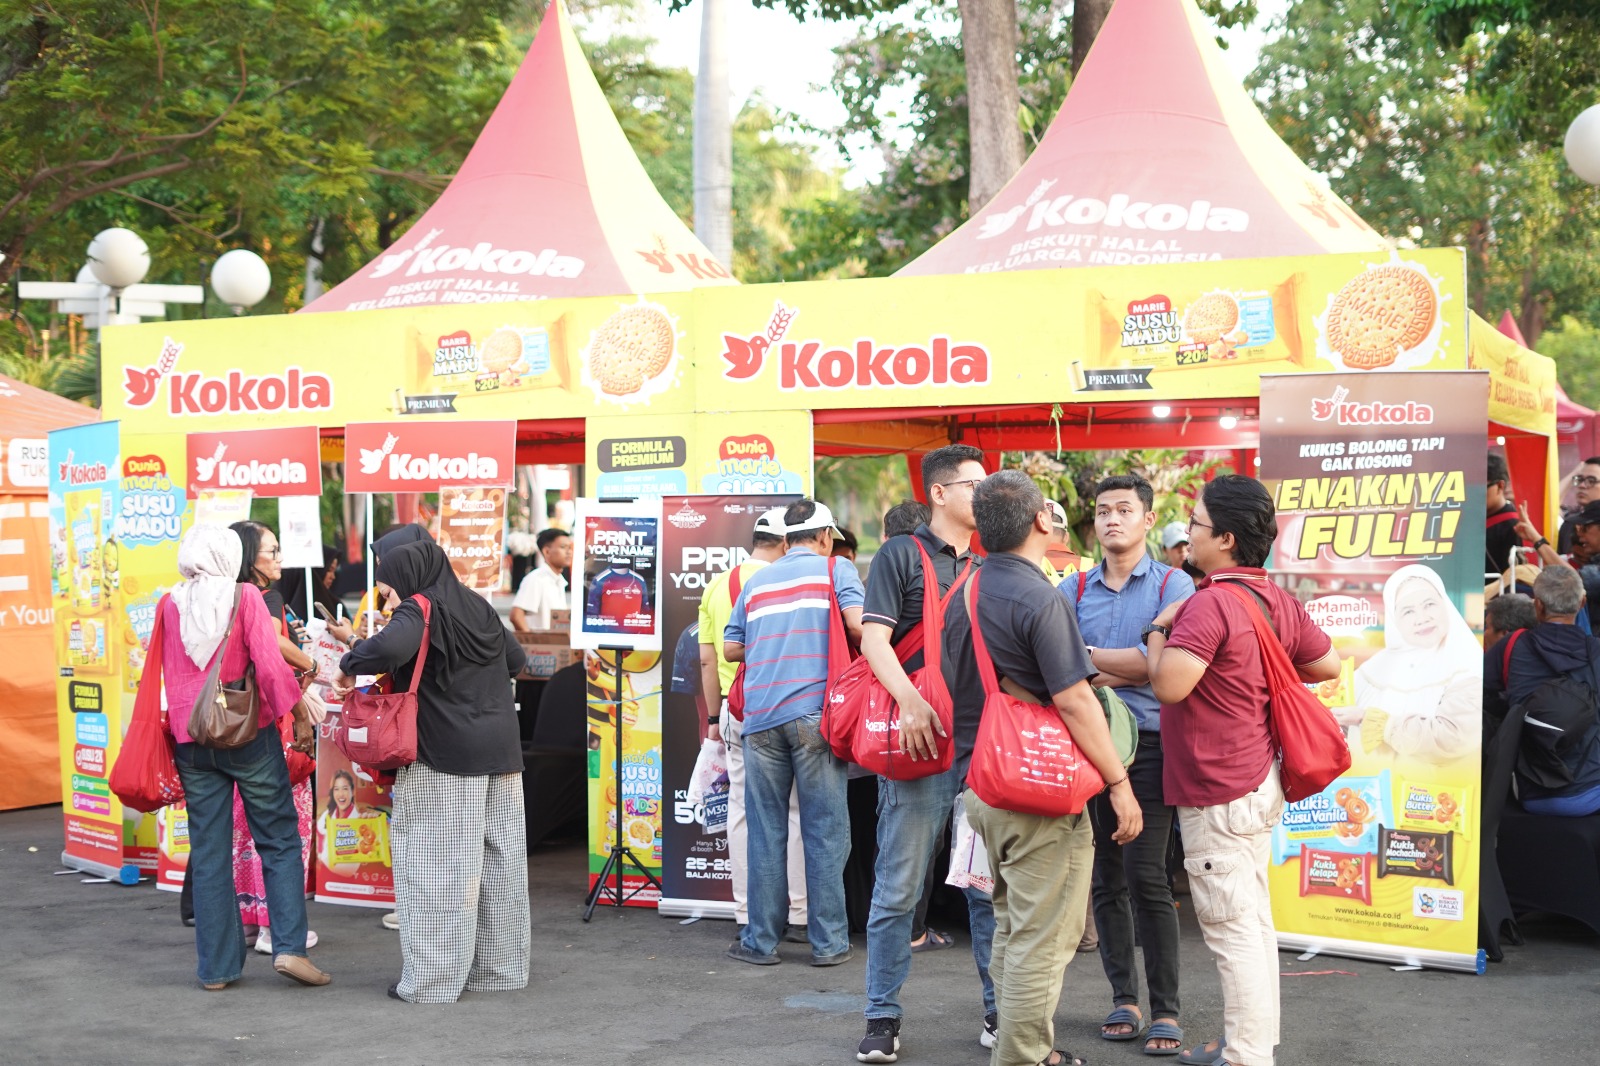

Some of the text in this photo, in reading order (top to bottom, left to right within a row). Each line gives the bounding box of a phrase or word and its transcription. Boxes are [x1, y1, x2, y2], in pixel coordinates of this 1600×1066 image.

[1025, 193, 1249, 232] Kokola
[1009, 233, 1182, 256] BISKUIT HALAL
[405, 242, 586, 279] Kokola
[964, 249, 1223, 273] KELUARGA INDONESIA
[384, 278, 521, 297] BISKUIT HALAL
[346, 291, 436, 312] KELUARGA
[1132, 302, 1166, 313] MARIE
[1124, 311, 1176, 332] SUSU
[1350, 296, 1405, 330] MARIE
[441, 336, 467, 347] MARIE
[1121, 326, 1181, 347] MADU
[435, 345, 476, 362] SUSU
[1176, 349, 1209, 366] +20%
[432, 359, 480, 376] MADU
[781, 337, 988, 389] Kokola
[1088, 373, 1144, 386] PREMIUM
[171, 369, 331, 414] Kokola
[407, 399, 451, 410] PREMIUM
[1339, 402, 1432, 425] Kokola
[21, 446, 48, 460] RUS
[611, 440, 674, 455] FORMULA
[726, 439, 768, 455] Dunia
[1299, 436, 1445, 458] KUKIS BOLONG TAPI
[128, 459, 161, 473] Dunia
[389, 453, 498, 480] Kokola
[612, 452, 675, 467] PREMIUM
[719, 455, 782, 477] marie
[1321, 453, 1413, 472] GAK KOSONG
[21, 463, 48, 477] TUK
[70, 463, 107, 485] Kokola
[219, 458, 307, 487] Kokola
[124, 475, 172, 492] marie
[1277, 470, 1466, 511] ENAKNYA
[122, 494, 176, 517] SUSU
[118, 515, 182, 539] MADU
[1297, 510, 1462, 560] FULL!
[593, 530, 648, 545] PRINT
[588, 545, 654, 556] YOUR NAME
[669, 572, 714, 589] YOU
[1307, 600, 1369, 614] #Mamah
[622, 754, 654, 766] marie
[624, 797, 657, 814] KIDS
[1289, 794, 1330, 811] Kukis
[1405, 800, 1436, 812] Butter
[1409, 792, 1434, 803] Kukis
[707, 803, 728, 817] M30
[1282, 811, 1312, 825] Susu
[1386, 848, 1427, 859] Mochachino
[1390, 840, 1415, 850] Kukis
[1309, 867, 1339, 879] Kelapa
[1313, 859, 1337, 870] Kukis
[686, 871, 711, 879] BALAI
[1334, 906, 1402, 920] www.kokola.co.id
